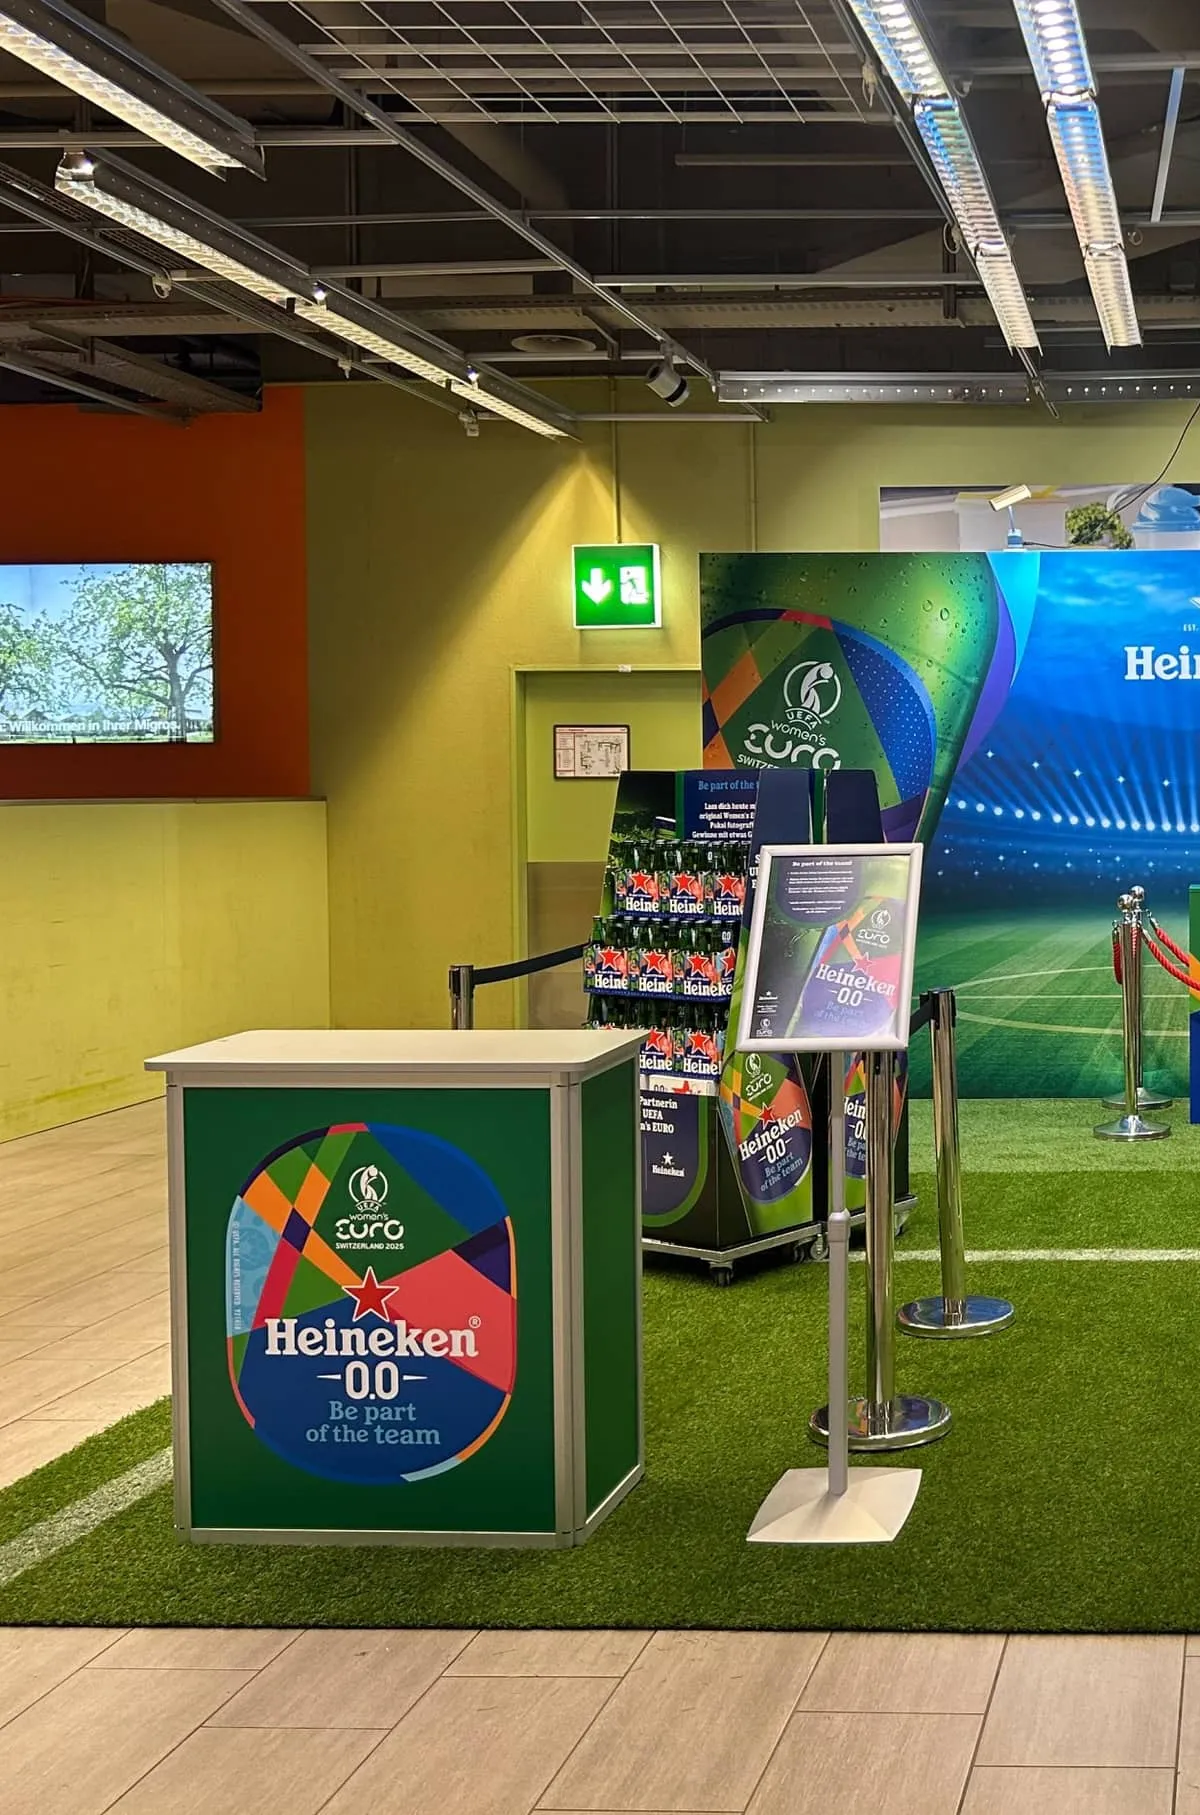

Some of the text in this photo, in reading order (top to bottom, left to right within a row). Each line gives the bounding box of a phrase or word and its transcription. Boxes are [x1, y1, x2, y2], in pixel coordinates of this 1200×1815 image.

[7, 720, 86, 732] Willkommen
[88, 719, 100, 731] in
[103, 719, 132, 731] Ihrer
[786, 711, 818, 729] UEFA
[771, 720, 827, 746] women's
[698, 781, 709, 790] Be
[710, 781, 729, 792] part
[730, 780, 742, 790] of
[742, 780, 755, 790] the
[815, 963, 897, 997] Heineken
[642, 1109, 664, 1120] UEFA
[652, 1122, 675, 1133] EURO
[738, 1109, 803, 1161] Heineken
[776, 1152, 794, 1173] part
[335, 1242, 405, 1250] SWITZERLAND 2025
[264, 1318, 479, 1358] Heineken
[344, 1360, 400, 1401] 0.0
[328, 1401, 416, 1425] Be part
[306, 1425, 441, 1446] of the team
